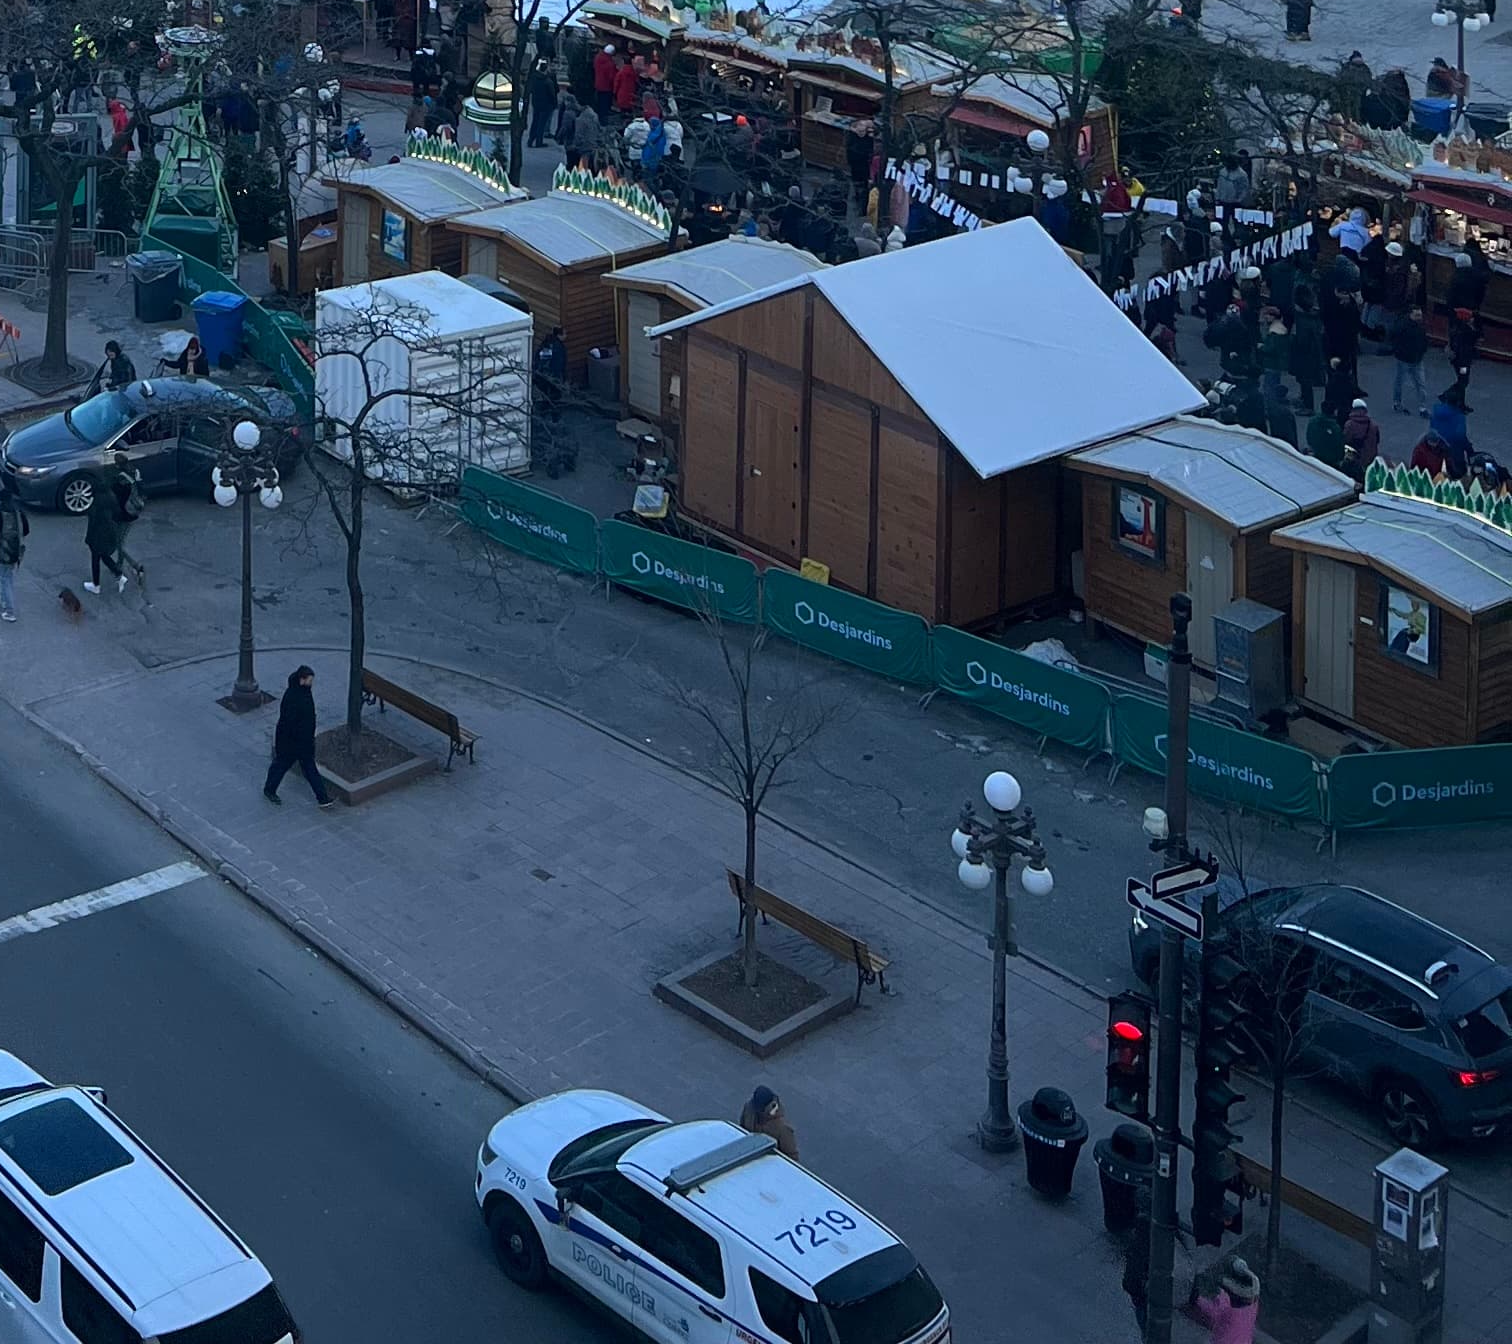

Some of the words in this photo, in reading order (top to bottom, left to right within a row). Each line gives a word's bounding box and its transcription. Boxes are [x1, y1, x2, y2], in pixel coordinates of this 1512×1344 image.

[654, 560, 725, 594] Desjardins
[818, 612, 893, 650] Desjardins
[991, 671, 1071, 716] Desjardins
[1402, 780, 1494, 802] Desjardins
[504, 1167, 527, 1190] 7219
[774, 1209, 857, 1255] 7219
[572, 1241, 656, 1316] POLICE
